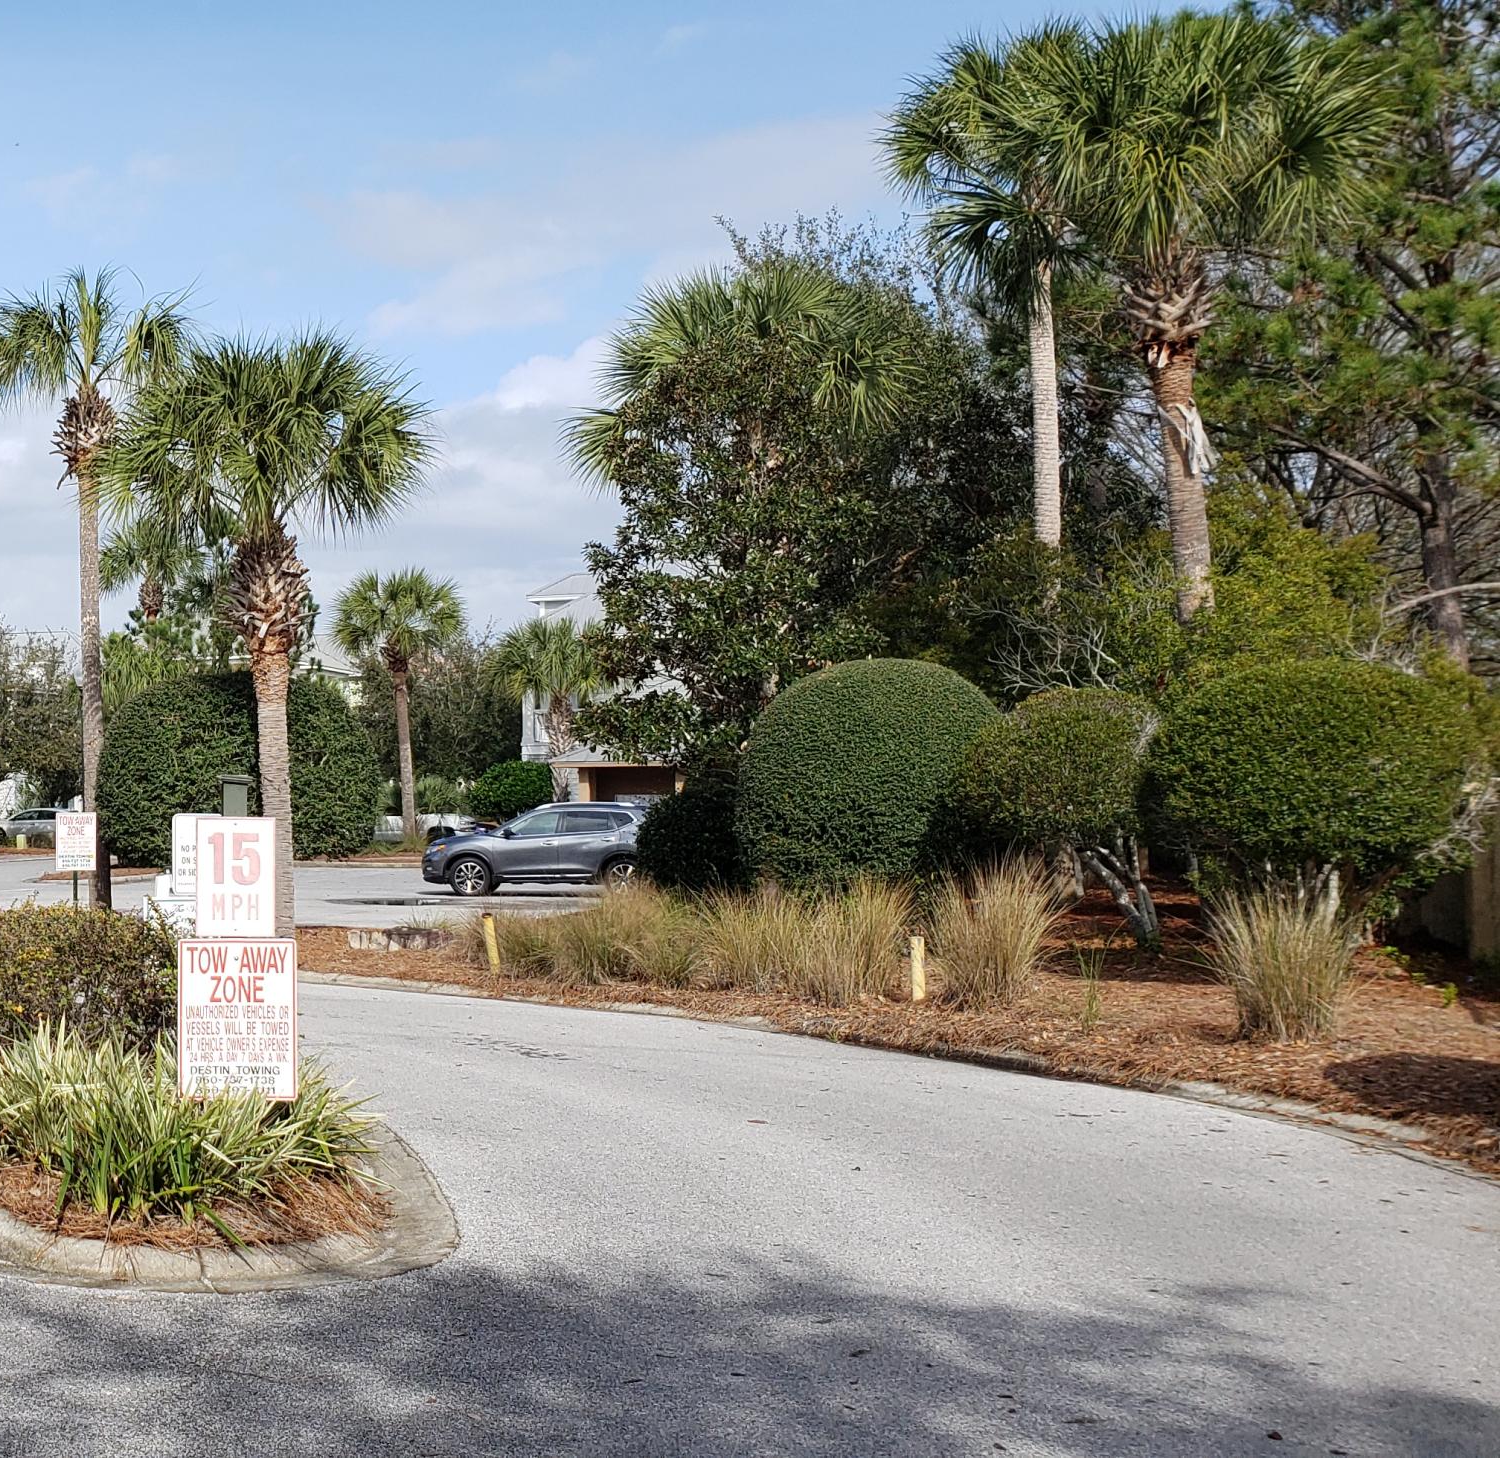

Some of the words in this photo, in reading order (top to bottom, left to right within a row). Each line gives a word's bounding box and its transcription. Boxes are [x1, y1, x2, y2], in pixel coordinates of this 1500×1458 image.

[59, 815, 74, 825] TOW
[75, 815, 94, 825] AWAY
[67, 825, 85, 836] ZONE
[181, 844, 190, 853] NO
[181, 856, 191, 865] ON
[207, 832, 261, 886] 15
[178, 868, 187, 877] OR
[212, 893, 259, 921] MPH
[186, 946, 228, 974] TOW
[239, 946, 288, 974] AWAY
[209, 975, 265, 1004] ZONE
[185, 1005, 239, 1020] UNAUTHORIZED
[242, 1005, 276, 1020] VEHICLES
[279, 1005, 289, 1020] OR
[186, 1021, 221, 1036] VESSELS
[224, 1021, 243, 1036] WILL
[246, 1021, 257, 1036] BE
[261, 1021, 290, 1036] TOWED
[186, 1037, 194, 1051] AT
[196, 1037, 224, 1051] VEHICLE
[259, 1037, 290, 1051] EXPENSE
[189, 1051, 198, 1063] 24
[218, 1051, 224, 1063] A
[226, 1051, 238, 1063] DAY
[241, 1051, 246, 1063] 7
[248, 1051, 265, 1063] DAYS
[267, 1051, 273, 1063] A
[190, 1065, 231, 1075] DESTIN
[236, 1065, 281, 1075] TOWING
